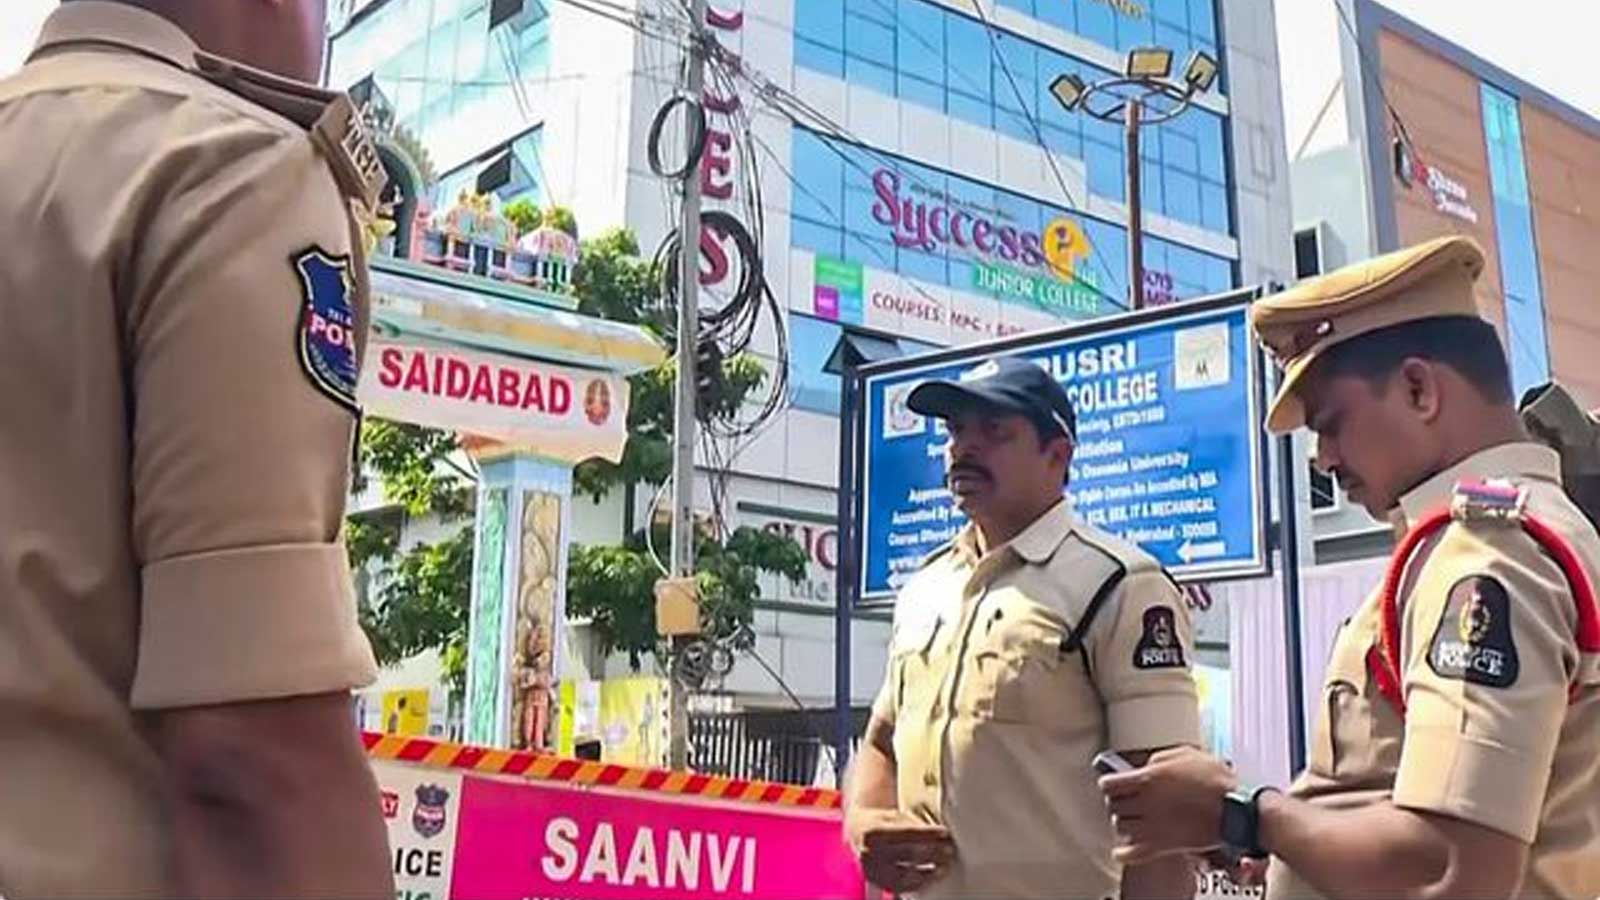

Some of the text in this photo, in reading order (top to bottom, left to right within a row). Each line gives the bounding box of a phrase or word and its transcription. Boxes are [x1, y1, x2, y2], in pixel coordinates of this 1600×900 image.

[1040, 339, 1137, 384] USRI
[377, 347, 572, 416] SAIDABAD
[1067, 371, 1158, 415] COLLEGE
[1129, 452, 1189, 472] University
[1150, 497, 1216, 518] MECHANICAL
[1437, 651, 1502, 677] POLICE
[394, 846, 442, 877] ICE
[540, 816, 757, 893] SAANVI
